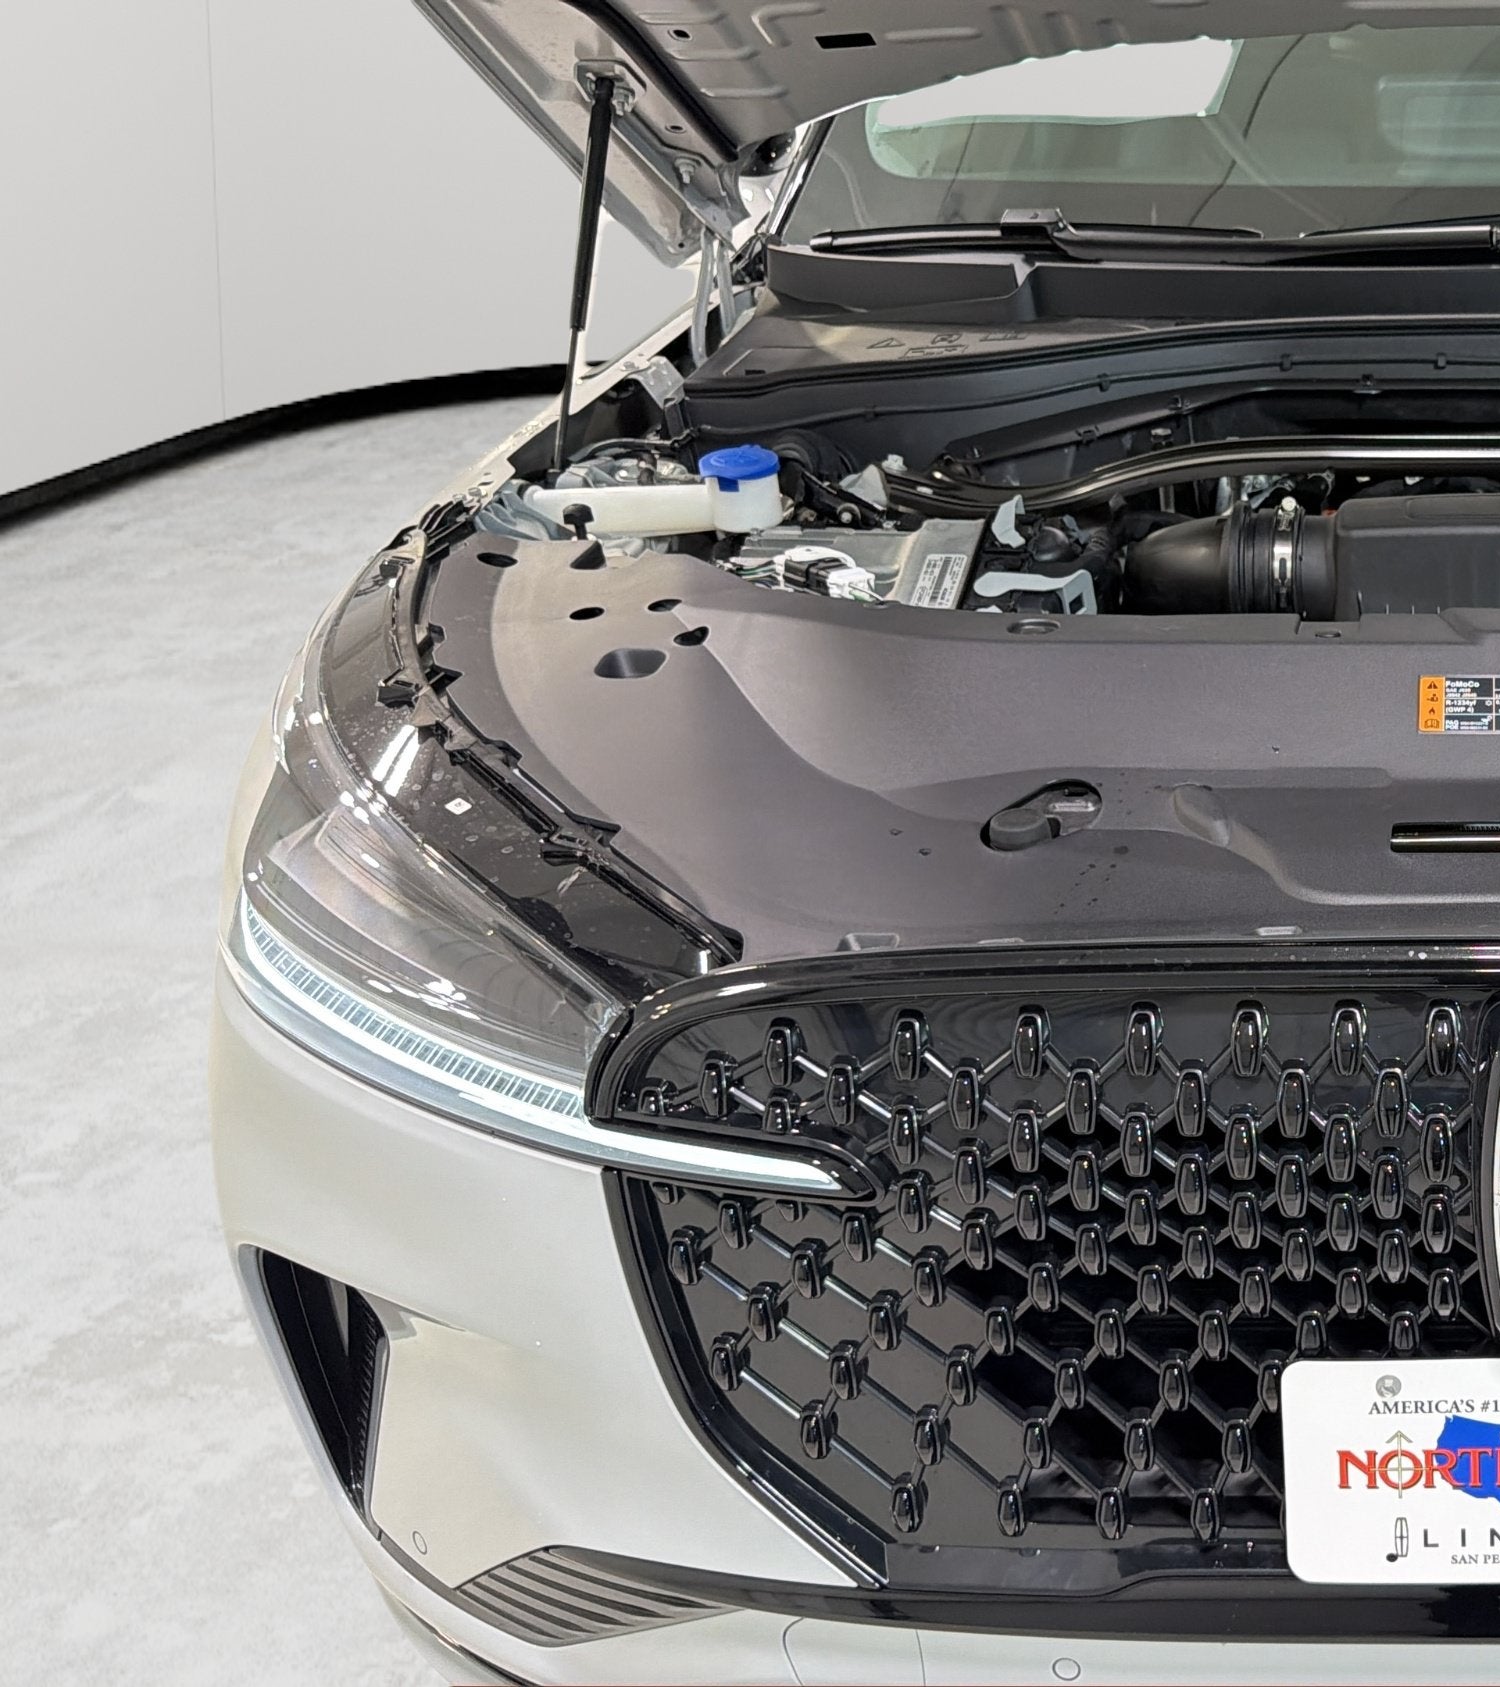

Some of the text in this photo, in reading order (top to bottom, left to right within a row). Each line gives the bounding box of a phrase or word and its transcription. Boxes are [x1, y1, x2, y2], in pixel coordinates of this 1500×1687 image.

[1368, 1400, 1475, 1415] AMERICA'S
[1480, 1399, 1500, 1413] #1
[1451, 1554, 1479, 1565] SAN
